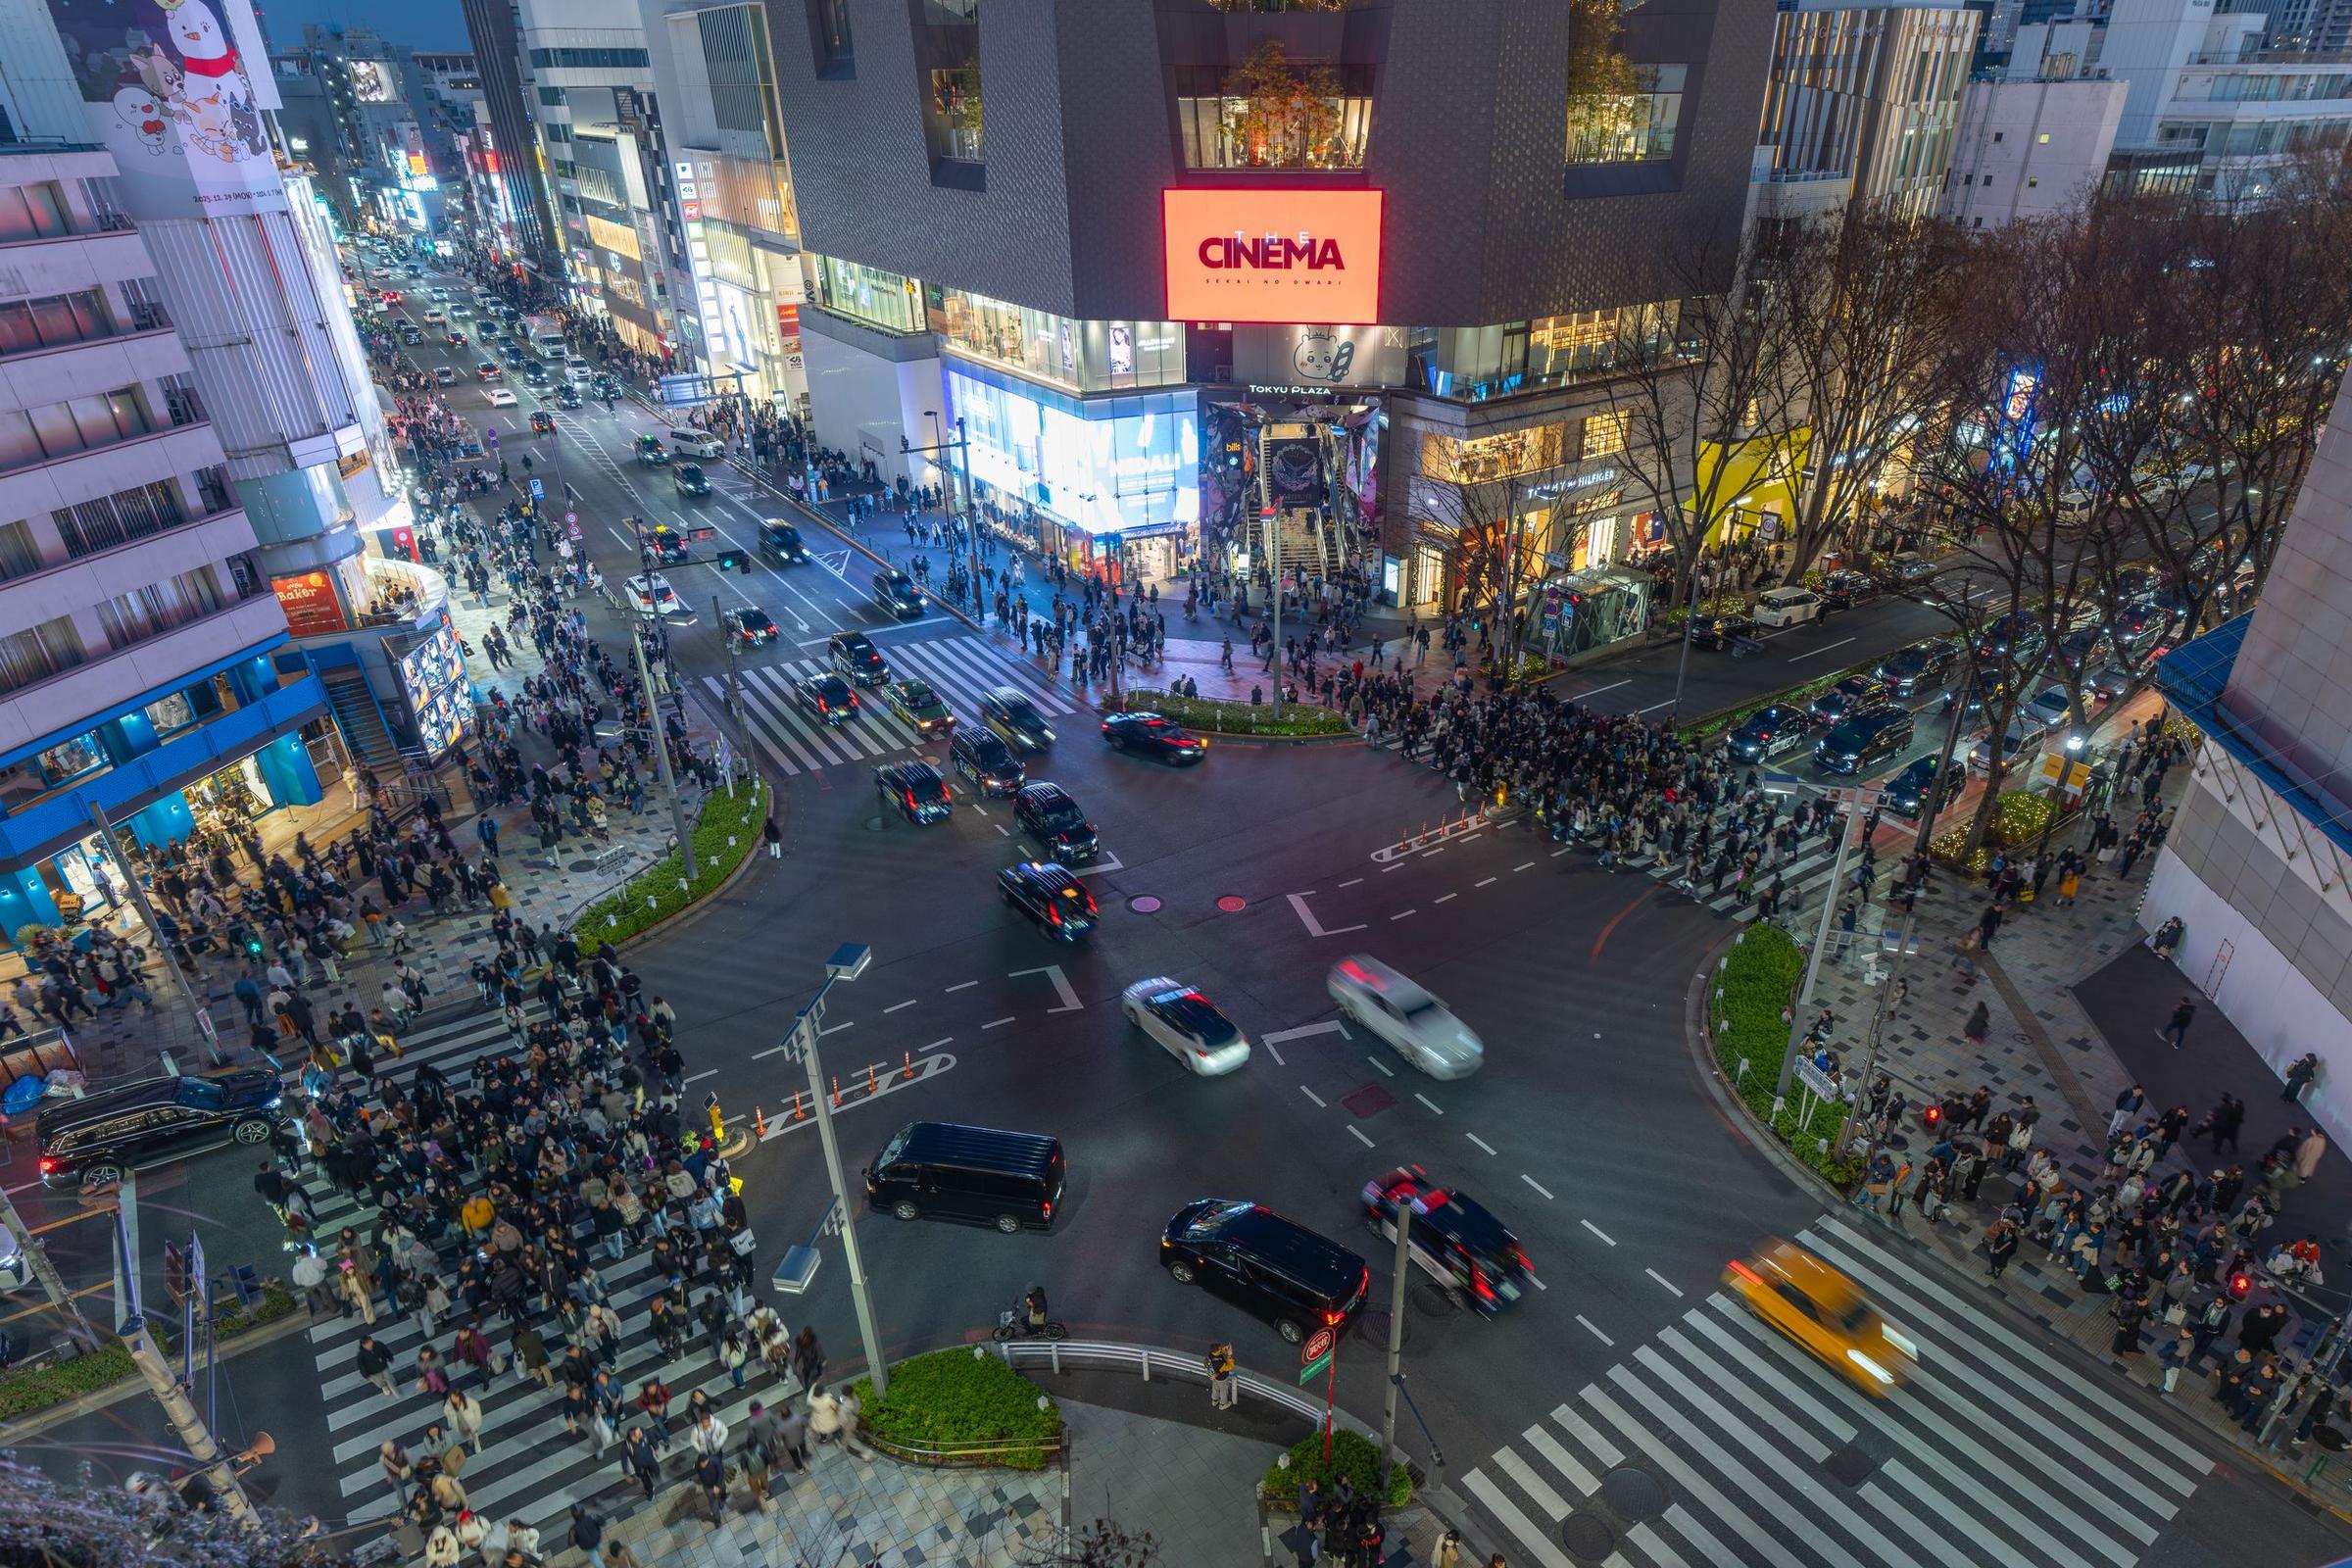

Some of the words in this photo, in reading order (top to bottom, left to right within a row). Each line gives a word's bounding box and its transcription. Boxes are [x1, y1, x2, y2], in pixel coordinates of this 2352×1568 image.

[1234, 230, 1310, 244] THE
[1199, 237, 1346, 270] CINEMA
[1249, 384, 1288, 394] TOKYU
[1291, 385, 1331, 395] PLAZA
[1225, 442, 1241, 452] bills
[1578, 468, 1615, 487] HILFIGER
[277, 588, 318, 602] Baker
